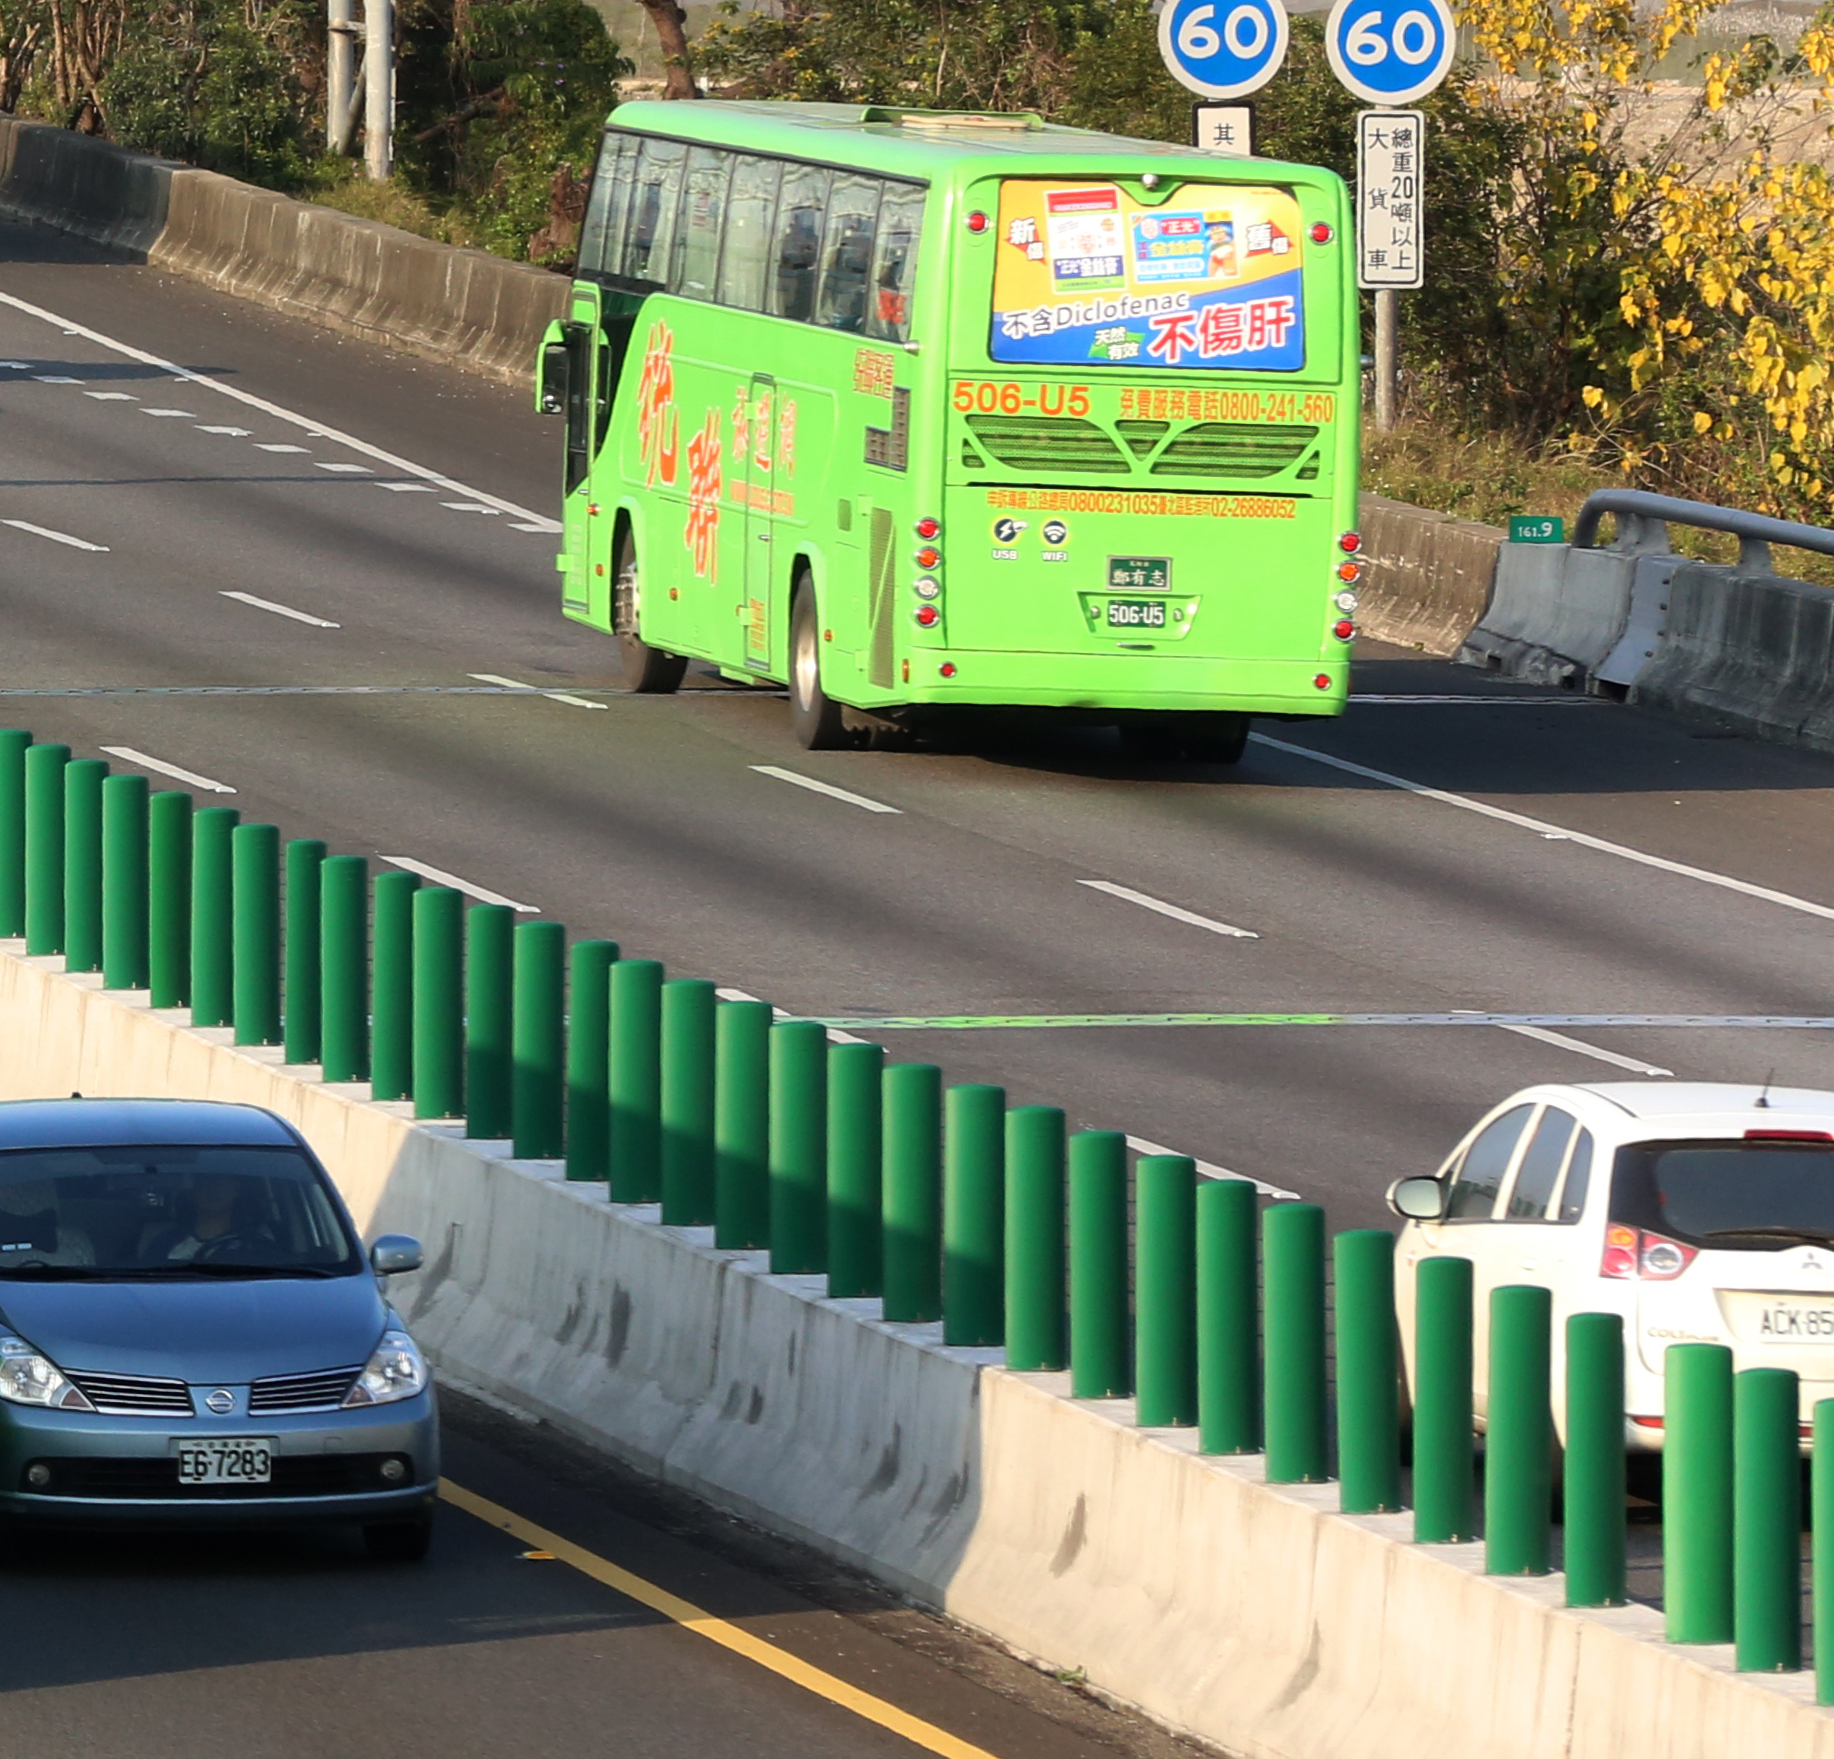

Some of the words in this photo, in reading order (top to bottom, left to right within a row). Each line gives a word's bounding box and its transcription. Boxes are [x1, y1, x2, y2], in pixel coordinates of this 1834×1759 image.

[1178, 4, 1269, 60] 60
[1345, 9, 1436, 66] 60
[1213, 123, 1235, 146] 其
[1367, 127, 1389, 270] 大貨車
[1390, 127, 1414, 270] 總重20噸以上
[1003, 292, 1189, 338] 不含Diclofenac
[1151, 299, 1294, 362] 不傷肝
[952, 381, 1090, 417] 506-U5
[1518, 522, 1554, 538] 161.9
[992, 550, 1018, 561] USB
[1041, 551, 1068, 562] WIFI
[1109, 604, 1164, 625] 506-U5
